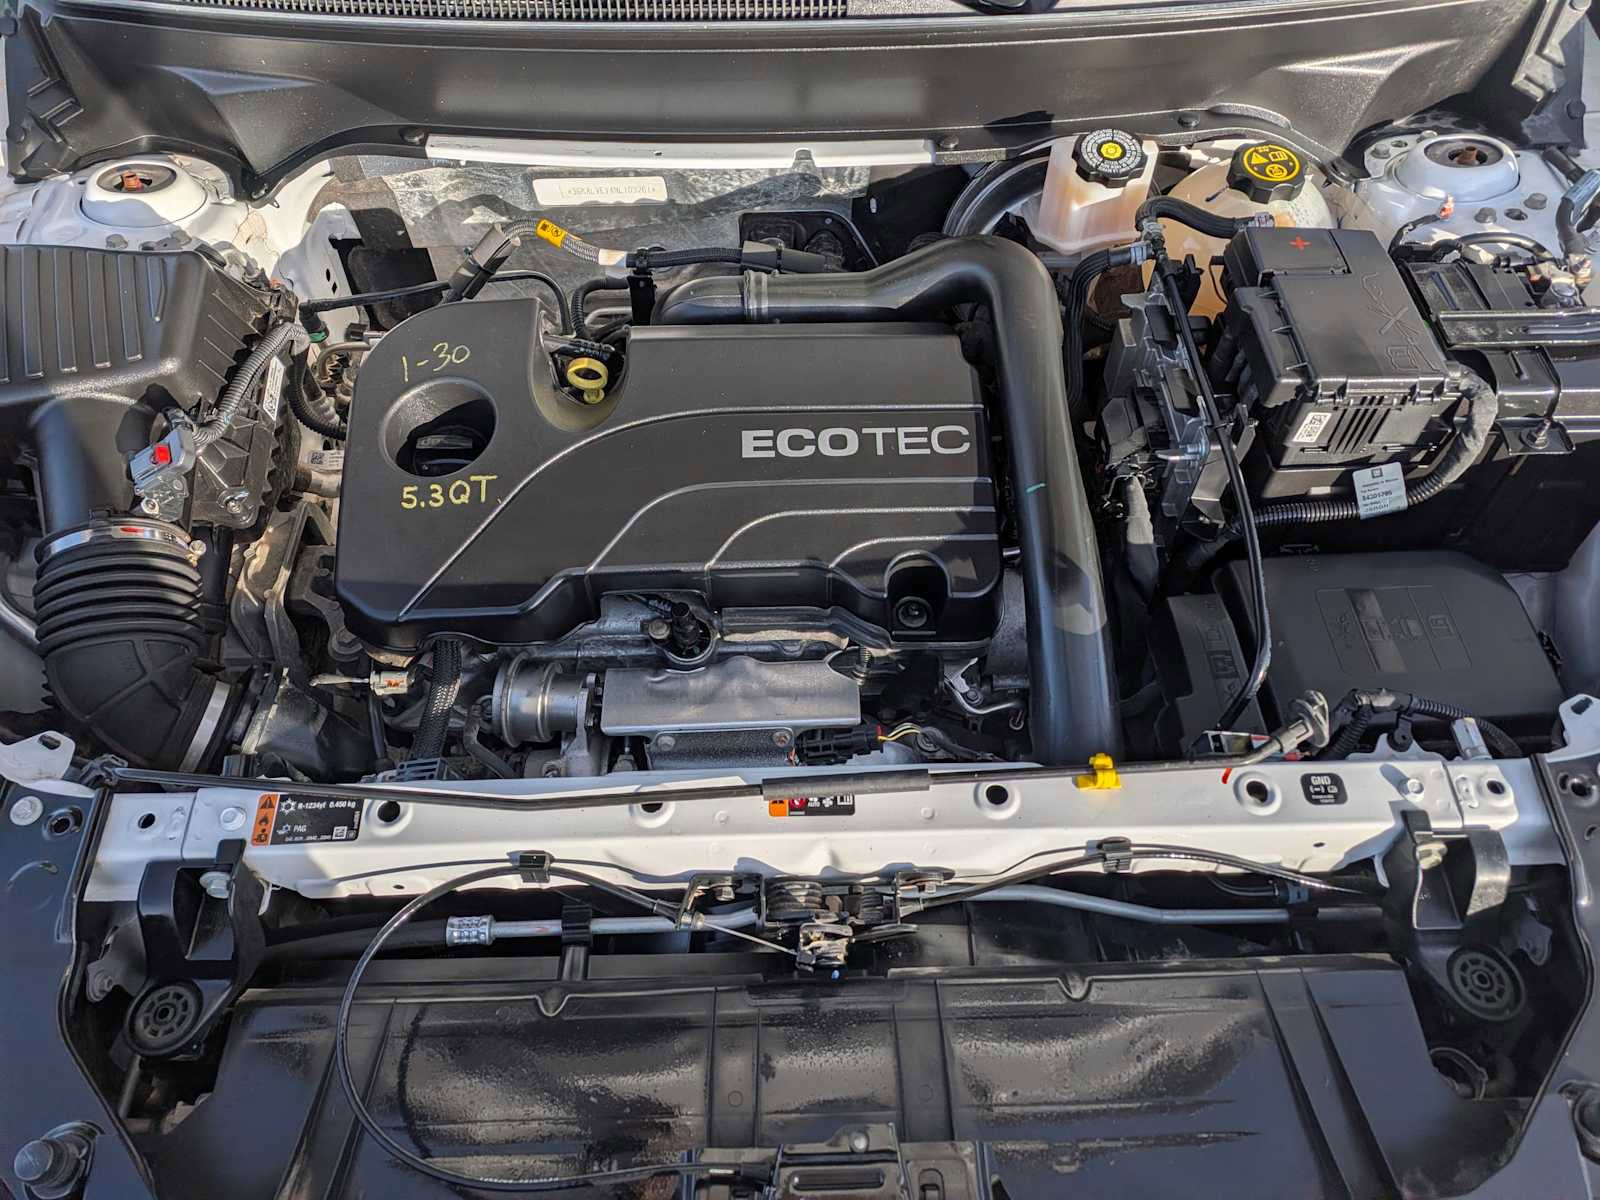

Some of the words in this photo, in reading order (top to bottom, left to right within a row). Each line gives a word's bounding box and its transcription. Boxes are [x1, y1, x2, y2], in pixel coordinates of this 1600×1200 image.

[741, 425, 971, 458] ECOTEC
[1310, 775, 1331, 785] GND
[297, 801, 327, 810] R-1234yf
[347, 800, 356, 809] kg
[292, 824, 307, 833] PAG
